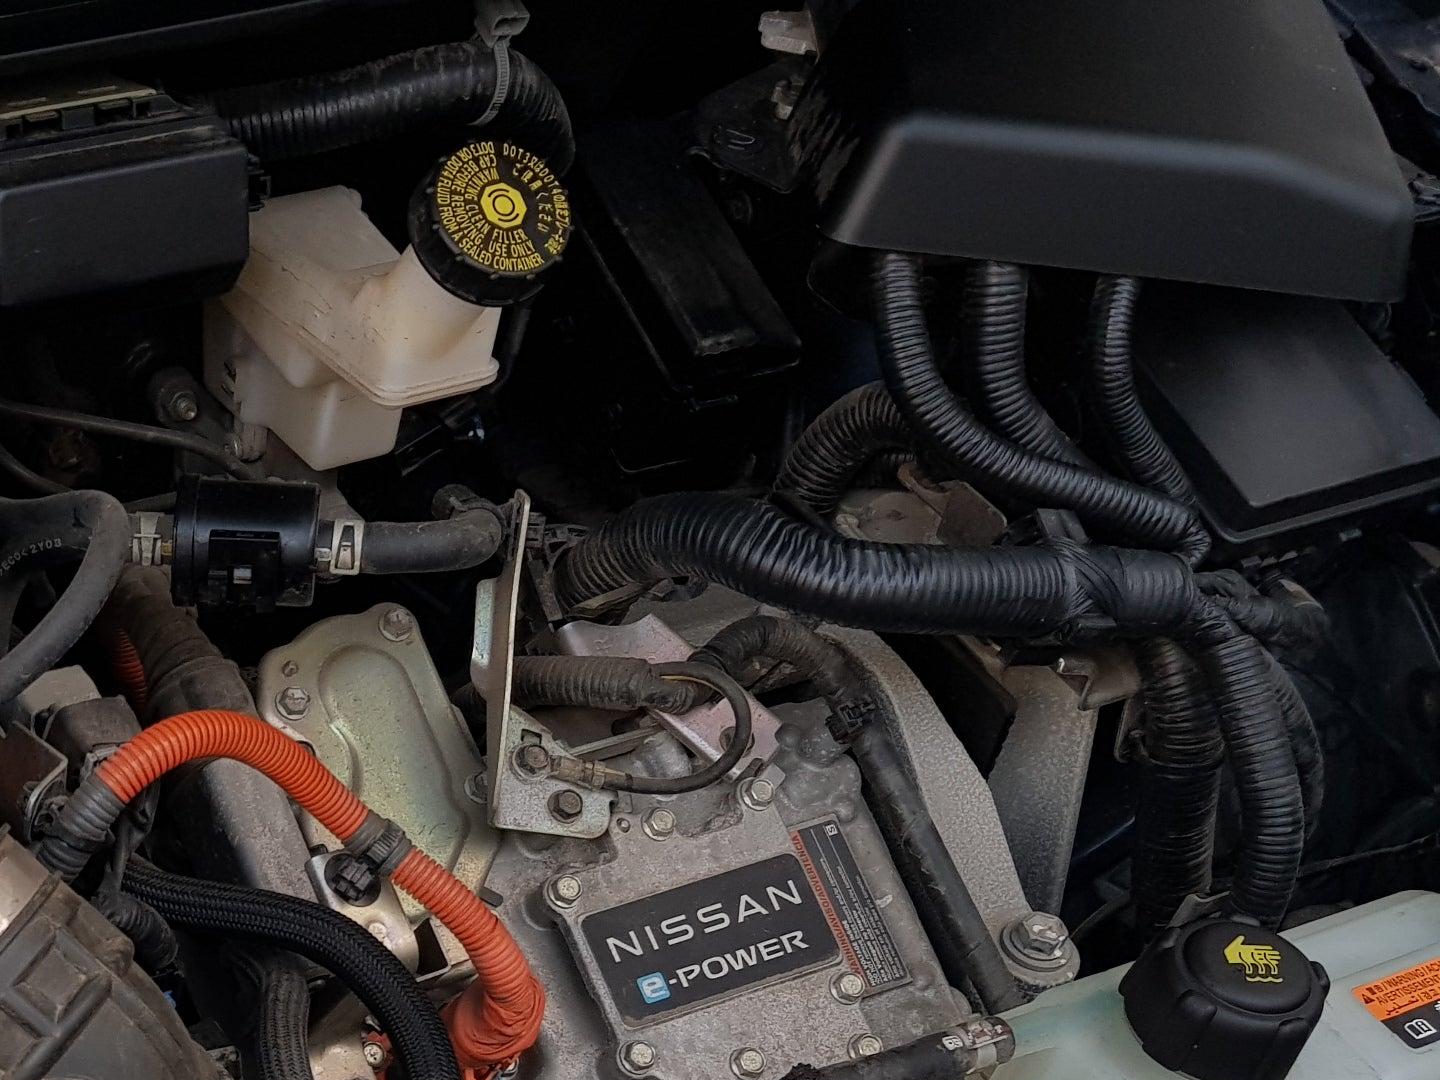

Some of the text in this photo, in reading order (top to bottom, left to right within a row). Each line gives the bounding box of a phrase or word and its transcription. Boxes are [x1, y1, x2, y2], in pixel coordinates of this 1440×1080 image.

[437, 141, 545, 272] DOT3 OR DOT4 FLUID FROM A SEALED CONTAINER
[451, 154, 536, 257] CAP BEFORE REMOVING. USE ONLY
[464, 167, 528, 243] WARNING CLEAN FILLER
[605, 879, 802, 963] NISSAN
[851, 940, 868, 969] VOLTAGE
[638, 930, 809, 1001] e-POWER
[1384, 968, 1425, 988] WARNING
